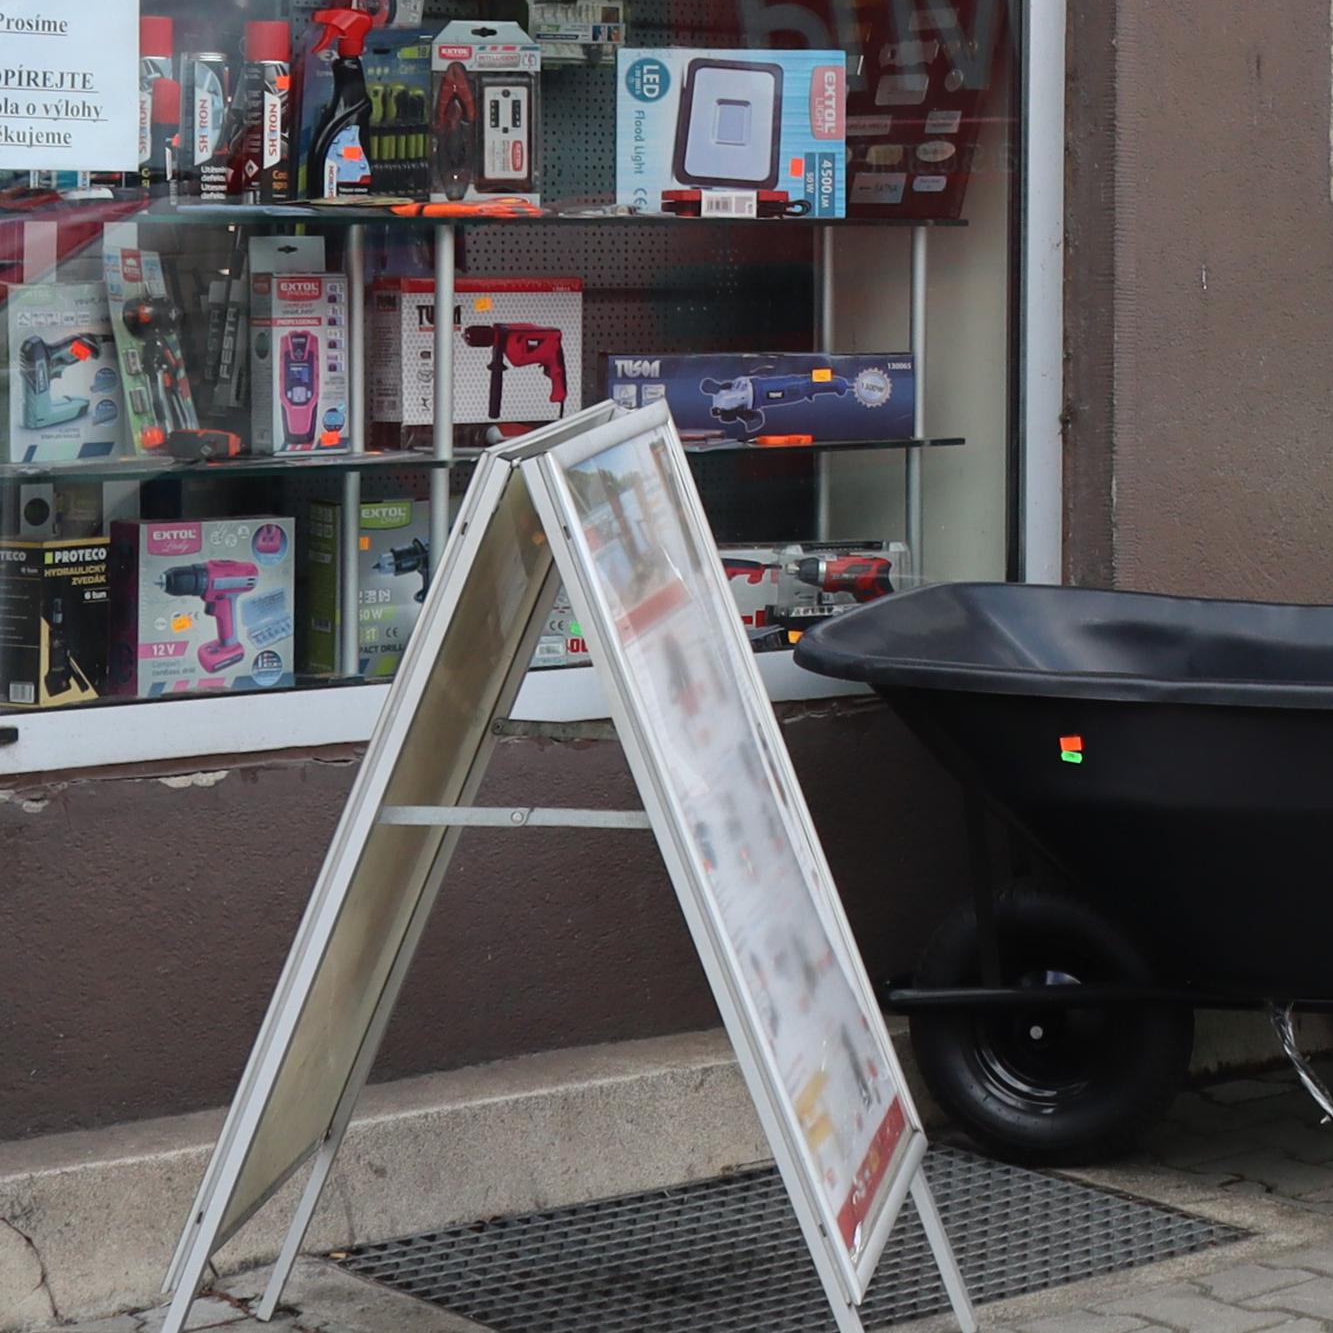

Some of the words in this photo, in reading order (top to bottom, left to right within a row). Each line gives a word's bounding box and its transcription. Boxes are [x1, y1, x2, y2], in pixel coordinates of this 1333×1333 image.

[0, 64, 94, 90] PÍREJTE
[643, 65, 660, 98] LED
[26, 102, 36, 116] o
[43, 98, 103, 123] výlohy
[824, 71, 837, 134] EXTOL
[634, 110, 645, 136] Flood
[0, 124, 72, 149] kujeme
[632, 138, 645, 175] Light
[821, 159, 832, 197] 4500
[280, 282, 319, 291] EXTOL
[219, 305, 238, 379] FESTA
[361, 507, 407, 518] EXTOL
[153, 529, 196, 541] EXTOL
[54, 548, 107, 564] PROTECO
